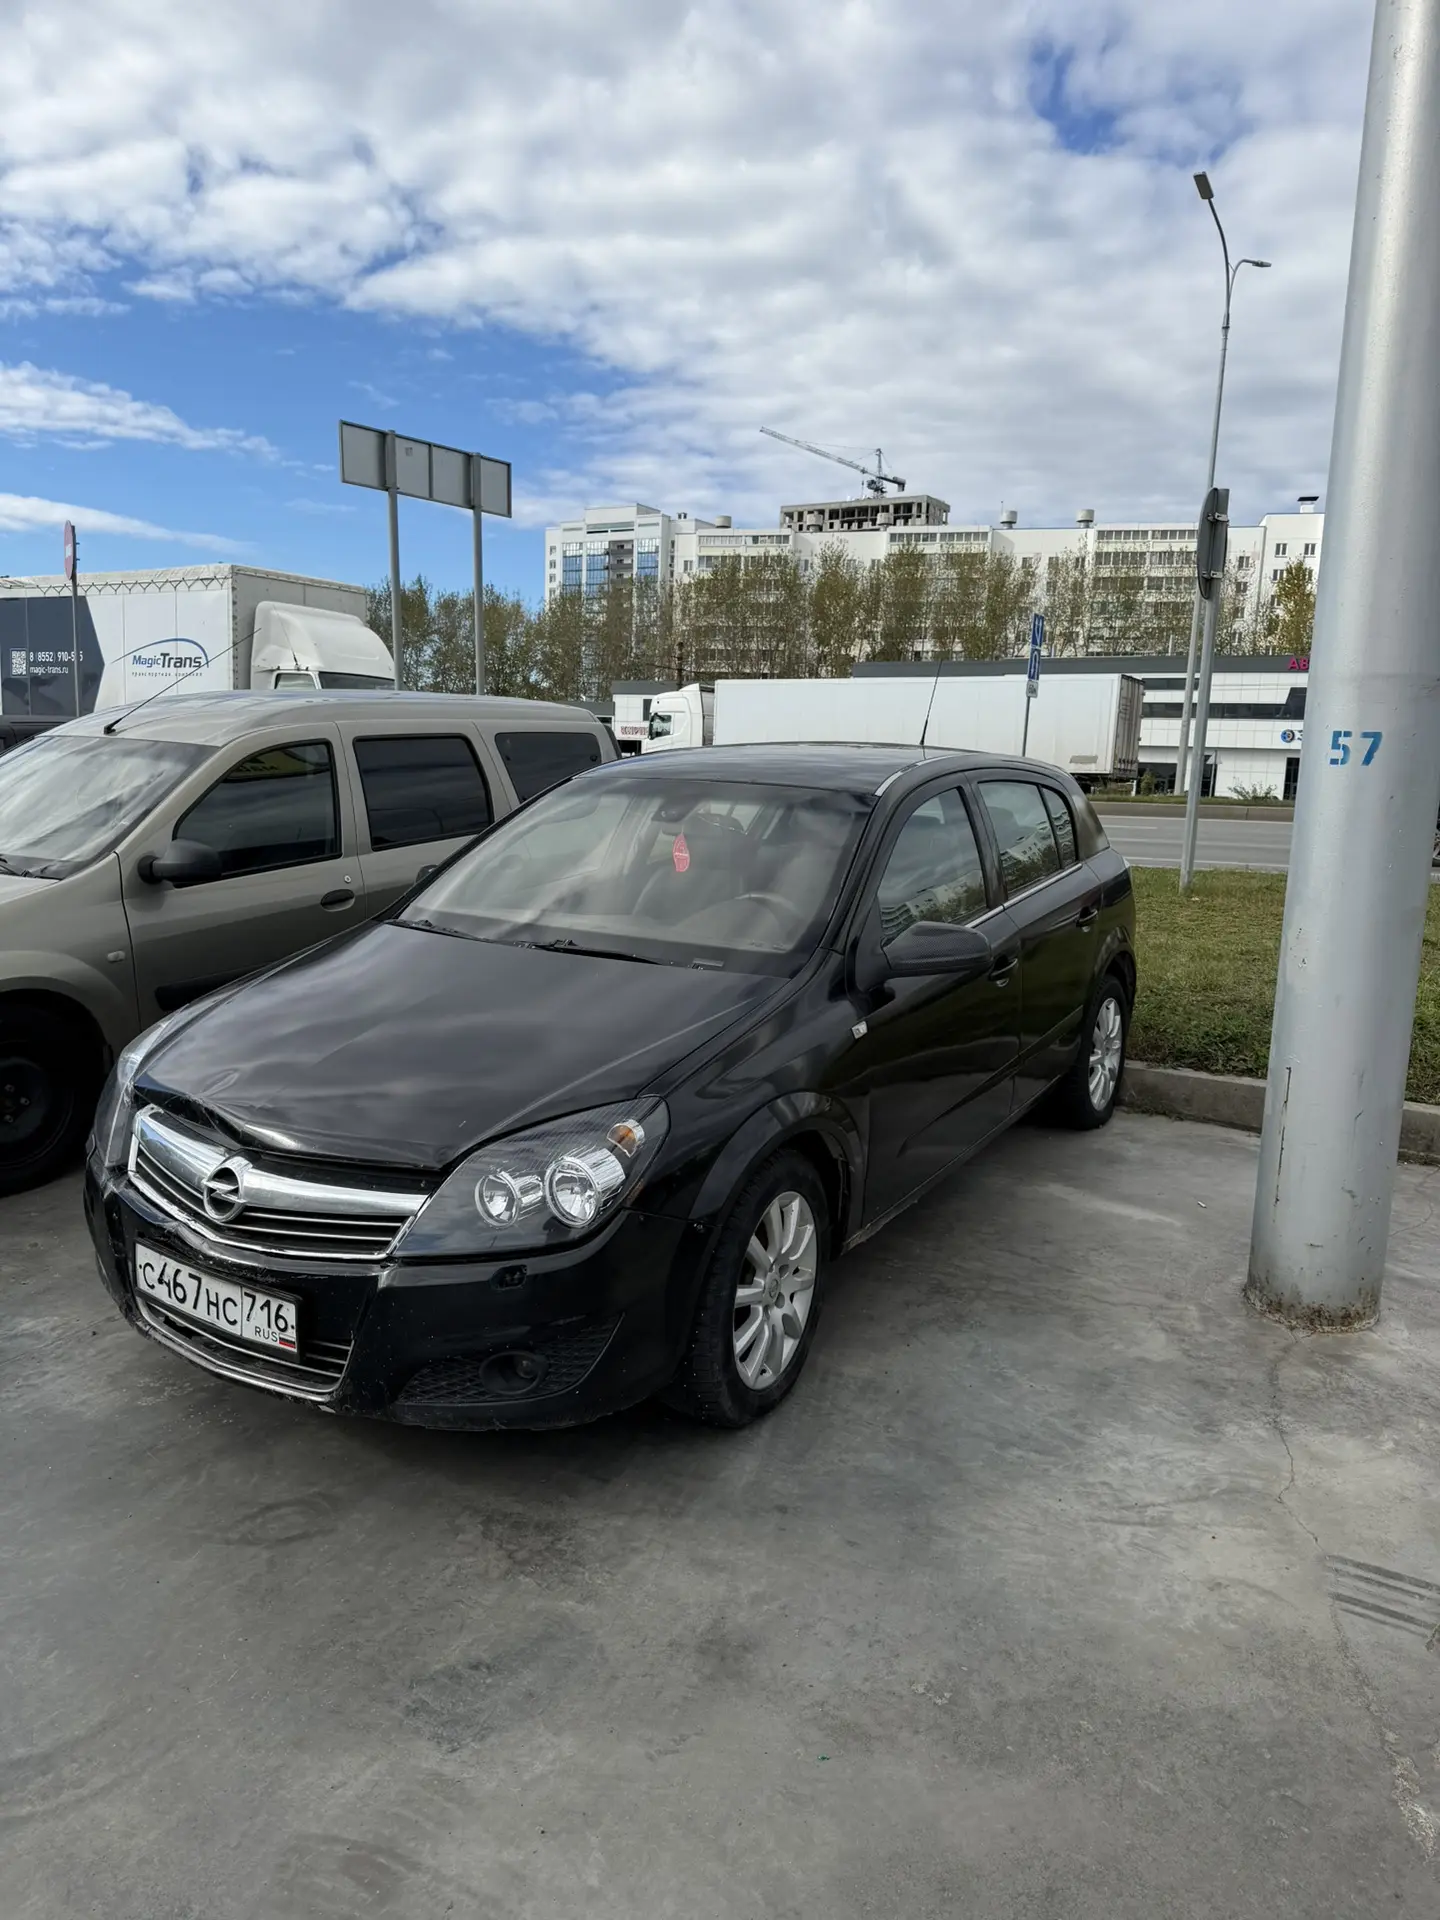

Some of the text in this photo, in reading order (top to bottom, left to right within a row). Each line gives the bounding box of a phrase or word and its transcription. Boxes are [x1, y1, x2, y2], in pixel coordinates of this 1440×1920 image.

[29, 651, 84, 663] 8 (8552) 910-55
[132, 653, 202, 668] MagicTrans
[30, 665, 69, 676] magic-trans.ru
[1329, 730, 1383, 766] 57
[254, 1326, 278, 1343] RUS
